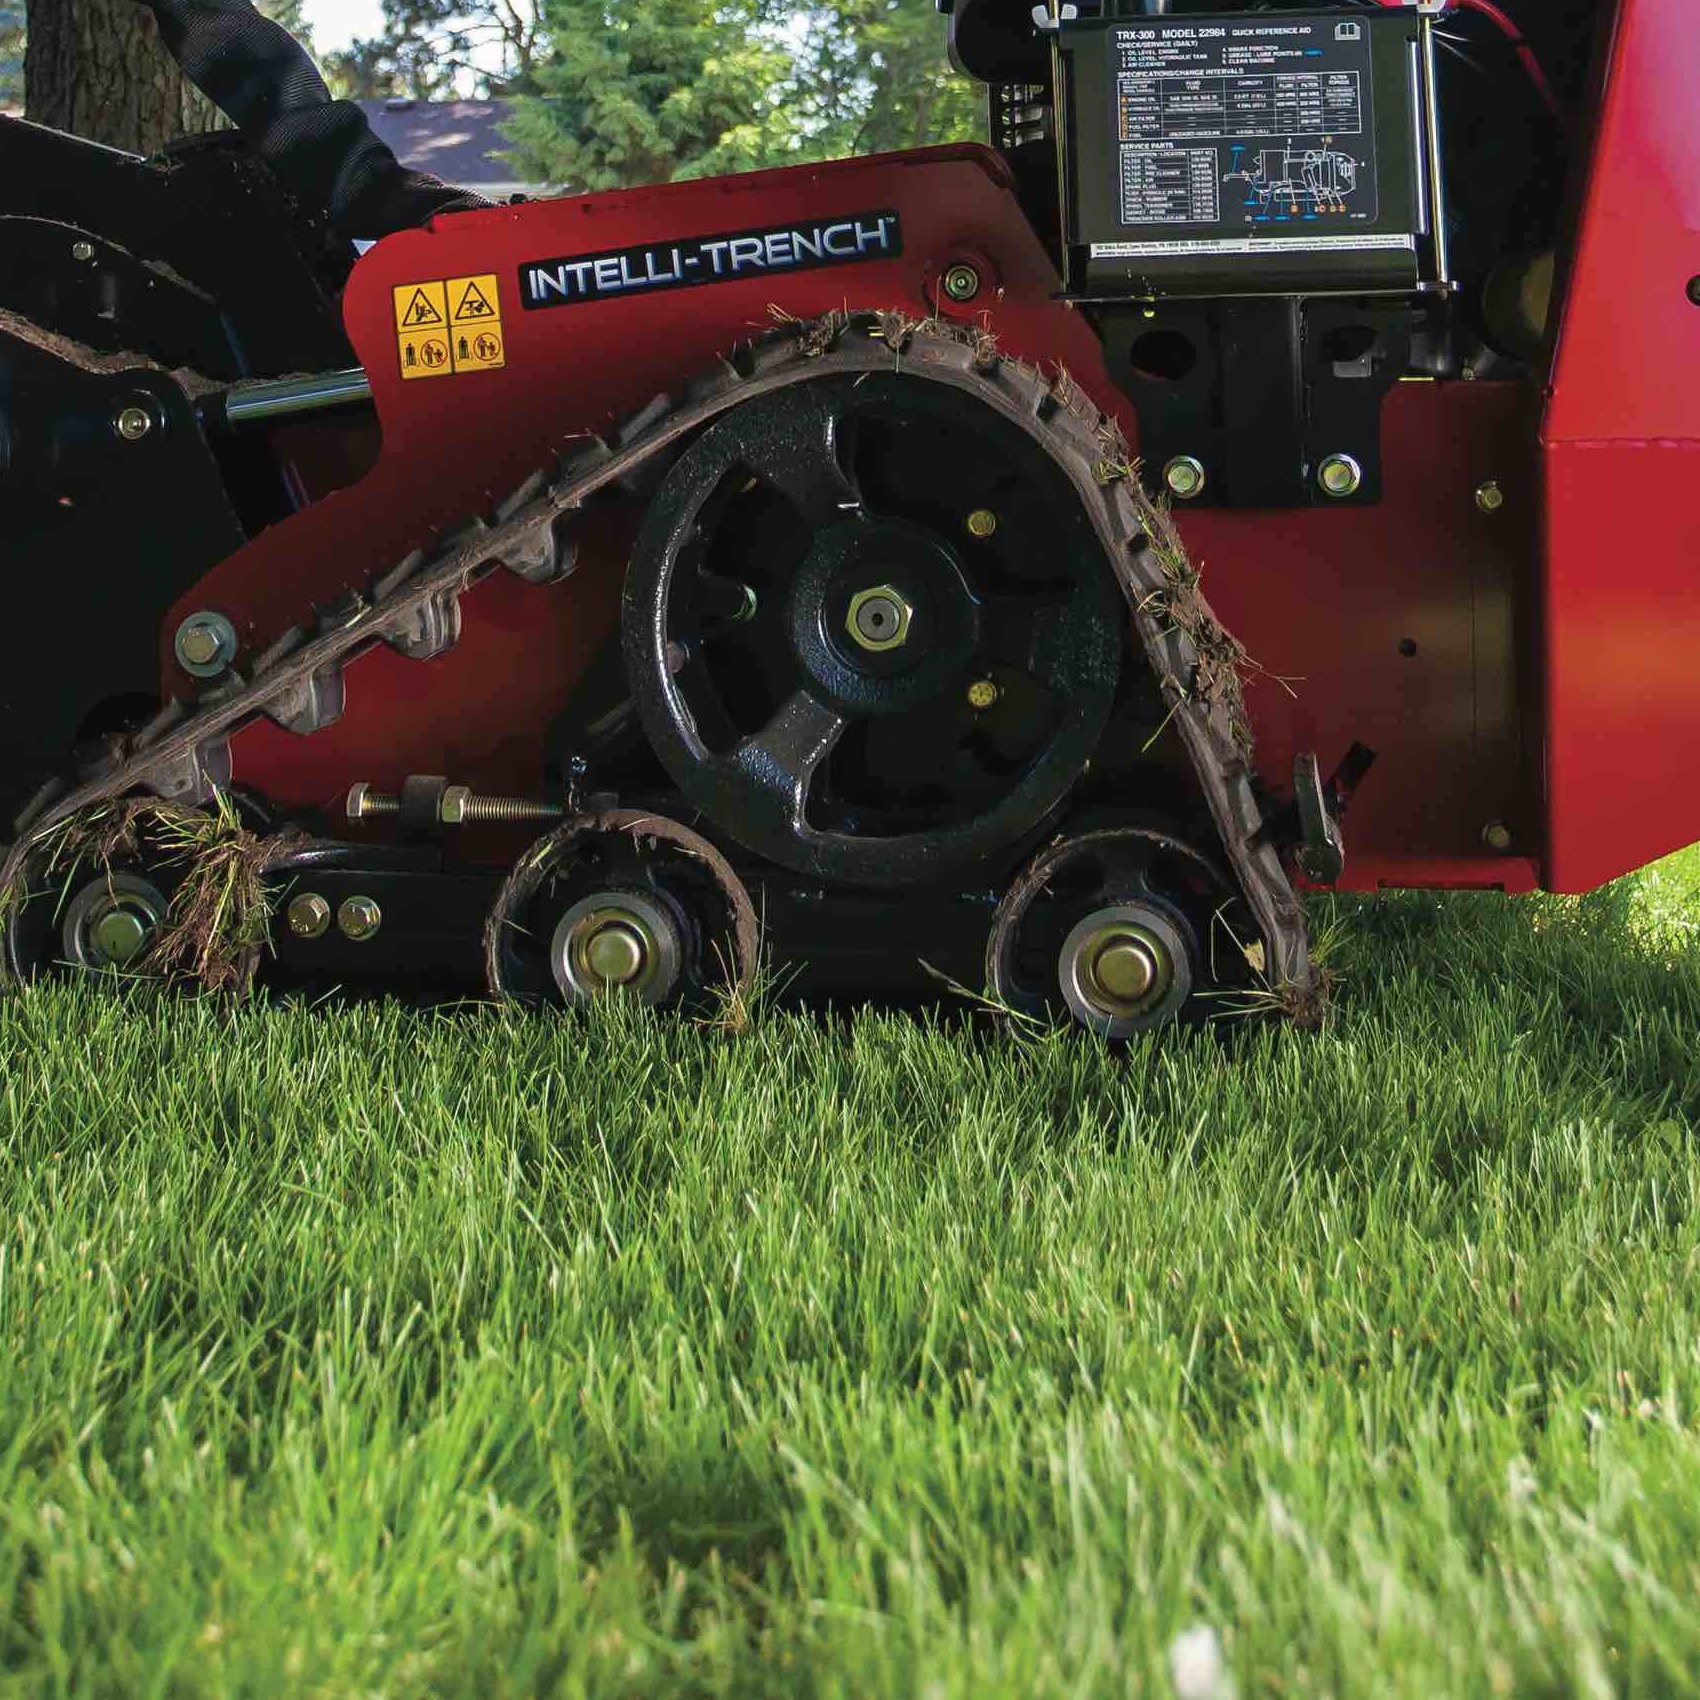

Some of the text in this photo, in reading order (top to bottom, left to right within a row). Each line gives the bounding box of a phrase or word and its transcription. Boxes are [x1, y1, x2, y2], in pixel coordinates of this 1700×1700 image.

[1116, 31, 1155, 40] TRX-300
[1162, 29, 1197, 39] MODEL
[1198, 28, 1226, 38] 22984
